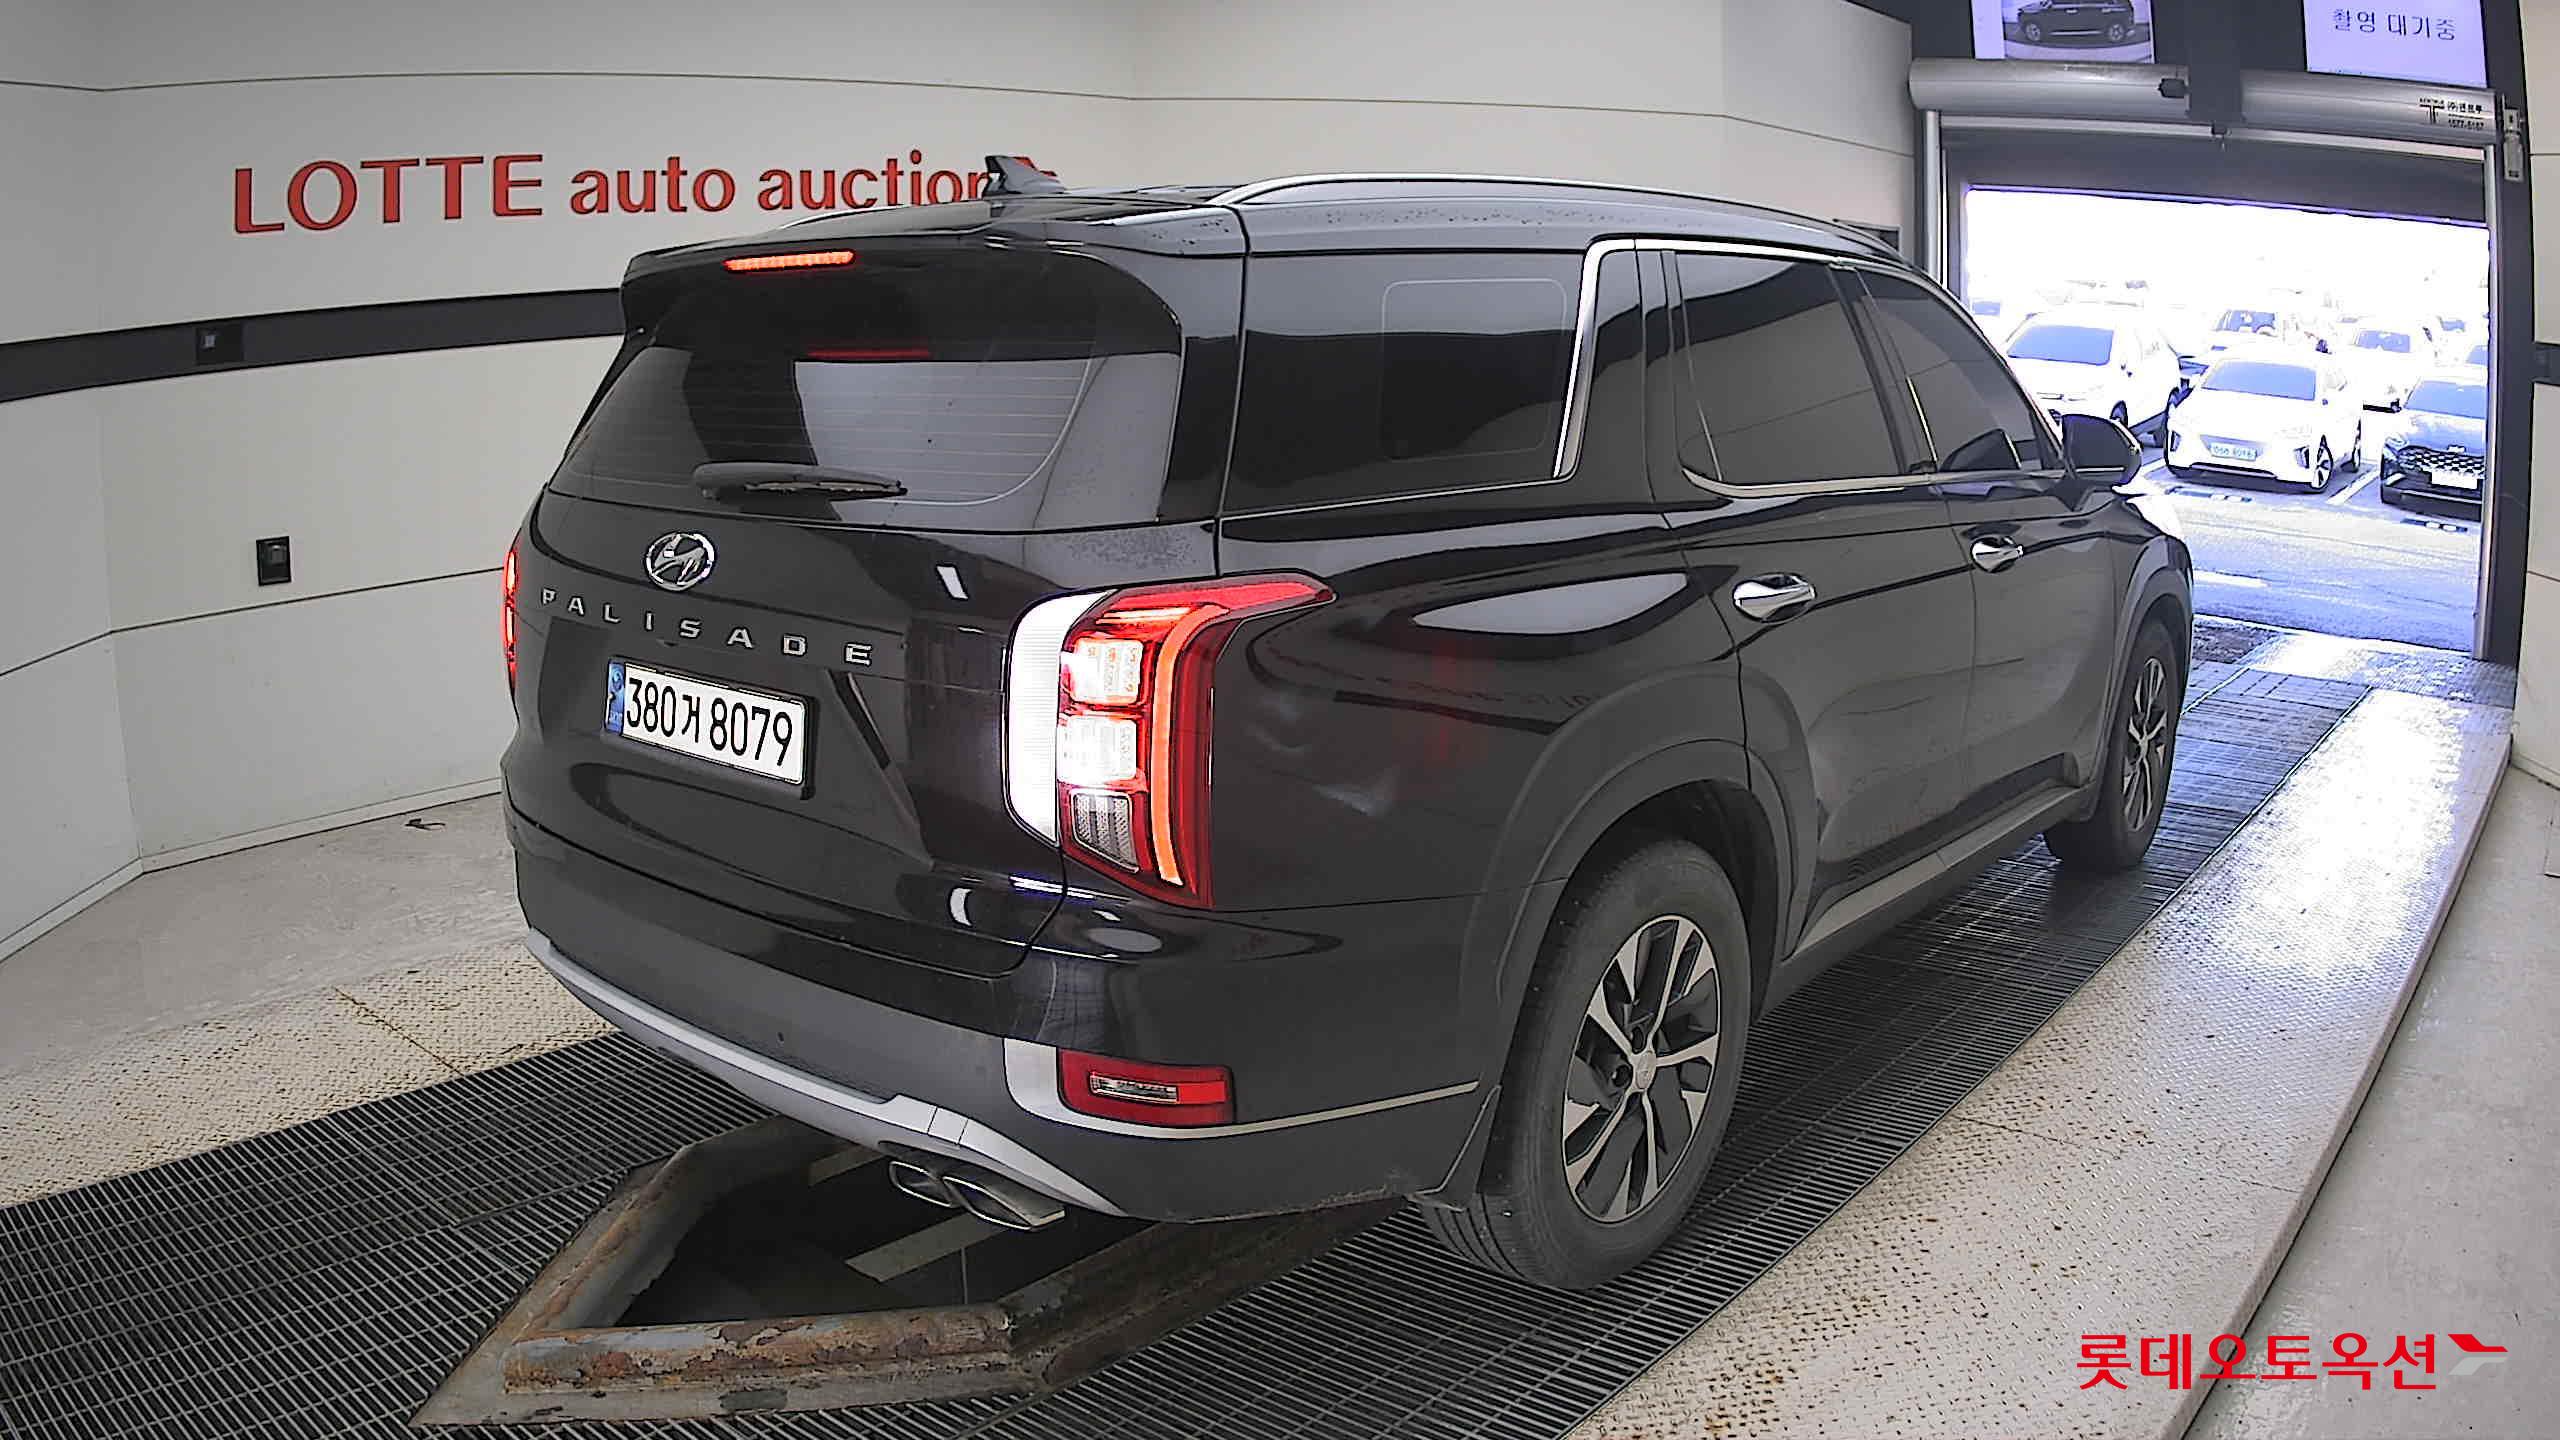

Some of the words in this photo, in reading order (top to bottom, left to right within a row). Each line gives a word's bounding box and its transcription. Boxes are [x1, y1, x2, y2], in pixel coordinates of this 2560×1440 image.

[2387, 14, 2455, 41] 대기중
[235, 154, 542, 233] LOTTE
[570, 157, 737, 214] auto
[542, 588, 873, 666] PALISADE
[627, 677, 700, 743] 380거
[710, 697, 793, 767] 8079
